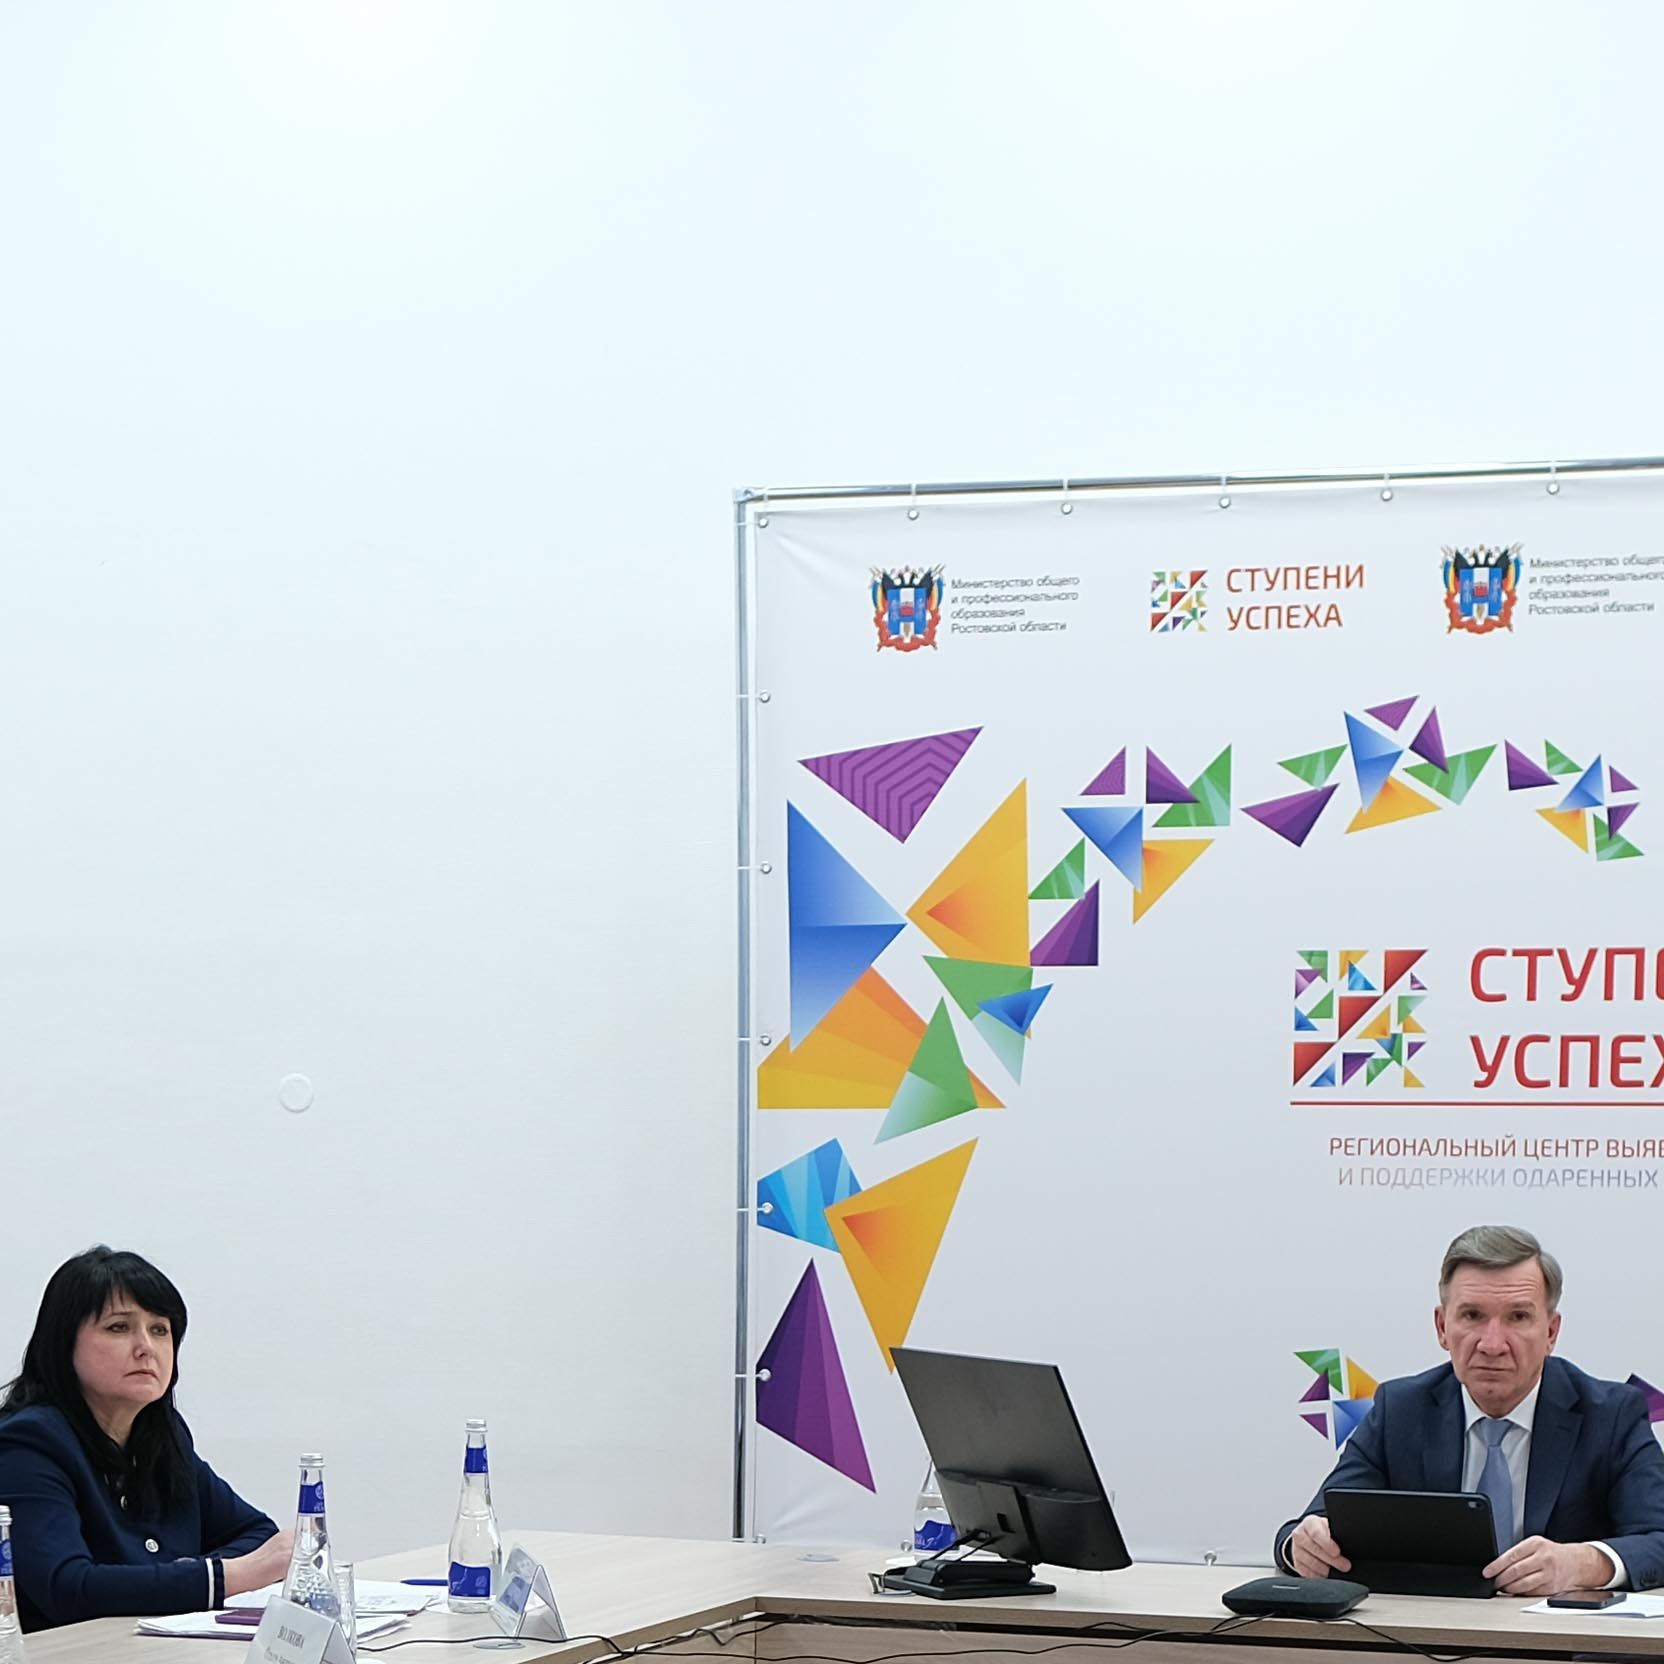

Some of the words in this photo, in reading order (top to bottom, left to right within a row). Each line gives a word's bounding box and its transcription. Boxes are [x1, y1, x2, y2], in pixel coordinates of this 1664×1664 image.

[1226, 563, 1364, 594] СТУПЕНИ
[1226, 603, 1343, 631] УСПЕХА
[1329, 1134, 1516, 1158] РЕГИОНАЛЬНЫЙ
[1523, 1138, 1599, 1161] ЦЕНТР
[1338, 1167, 1353, 1186] И
[1360, 1167, 1506, 1191] ПОДДЕРЖКИ
[1512, 1167, 1659, 1190] ОДАРЕННЫХ
